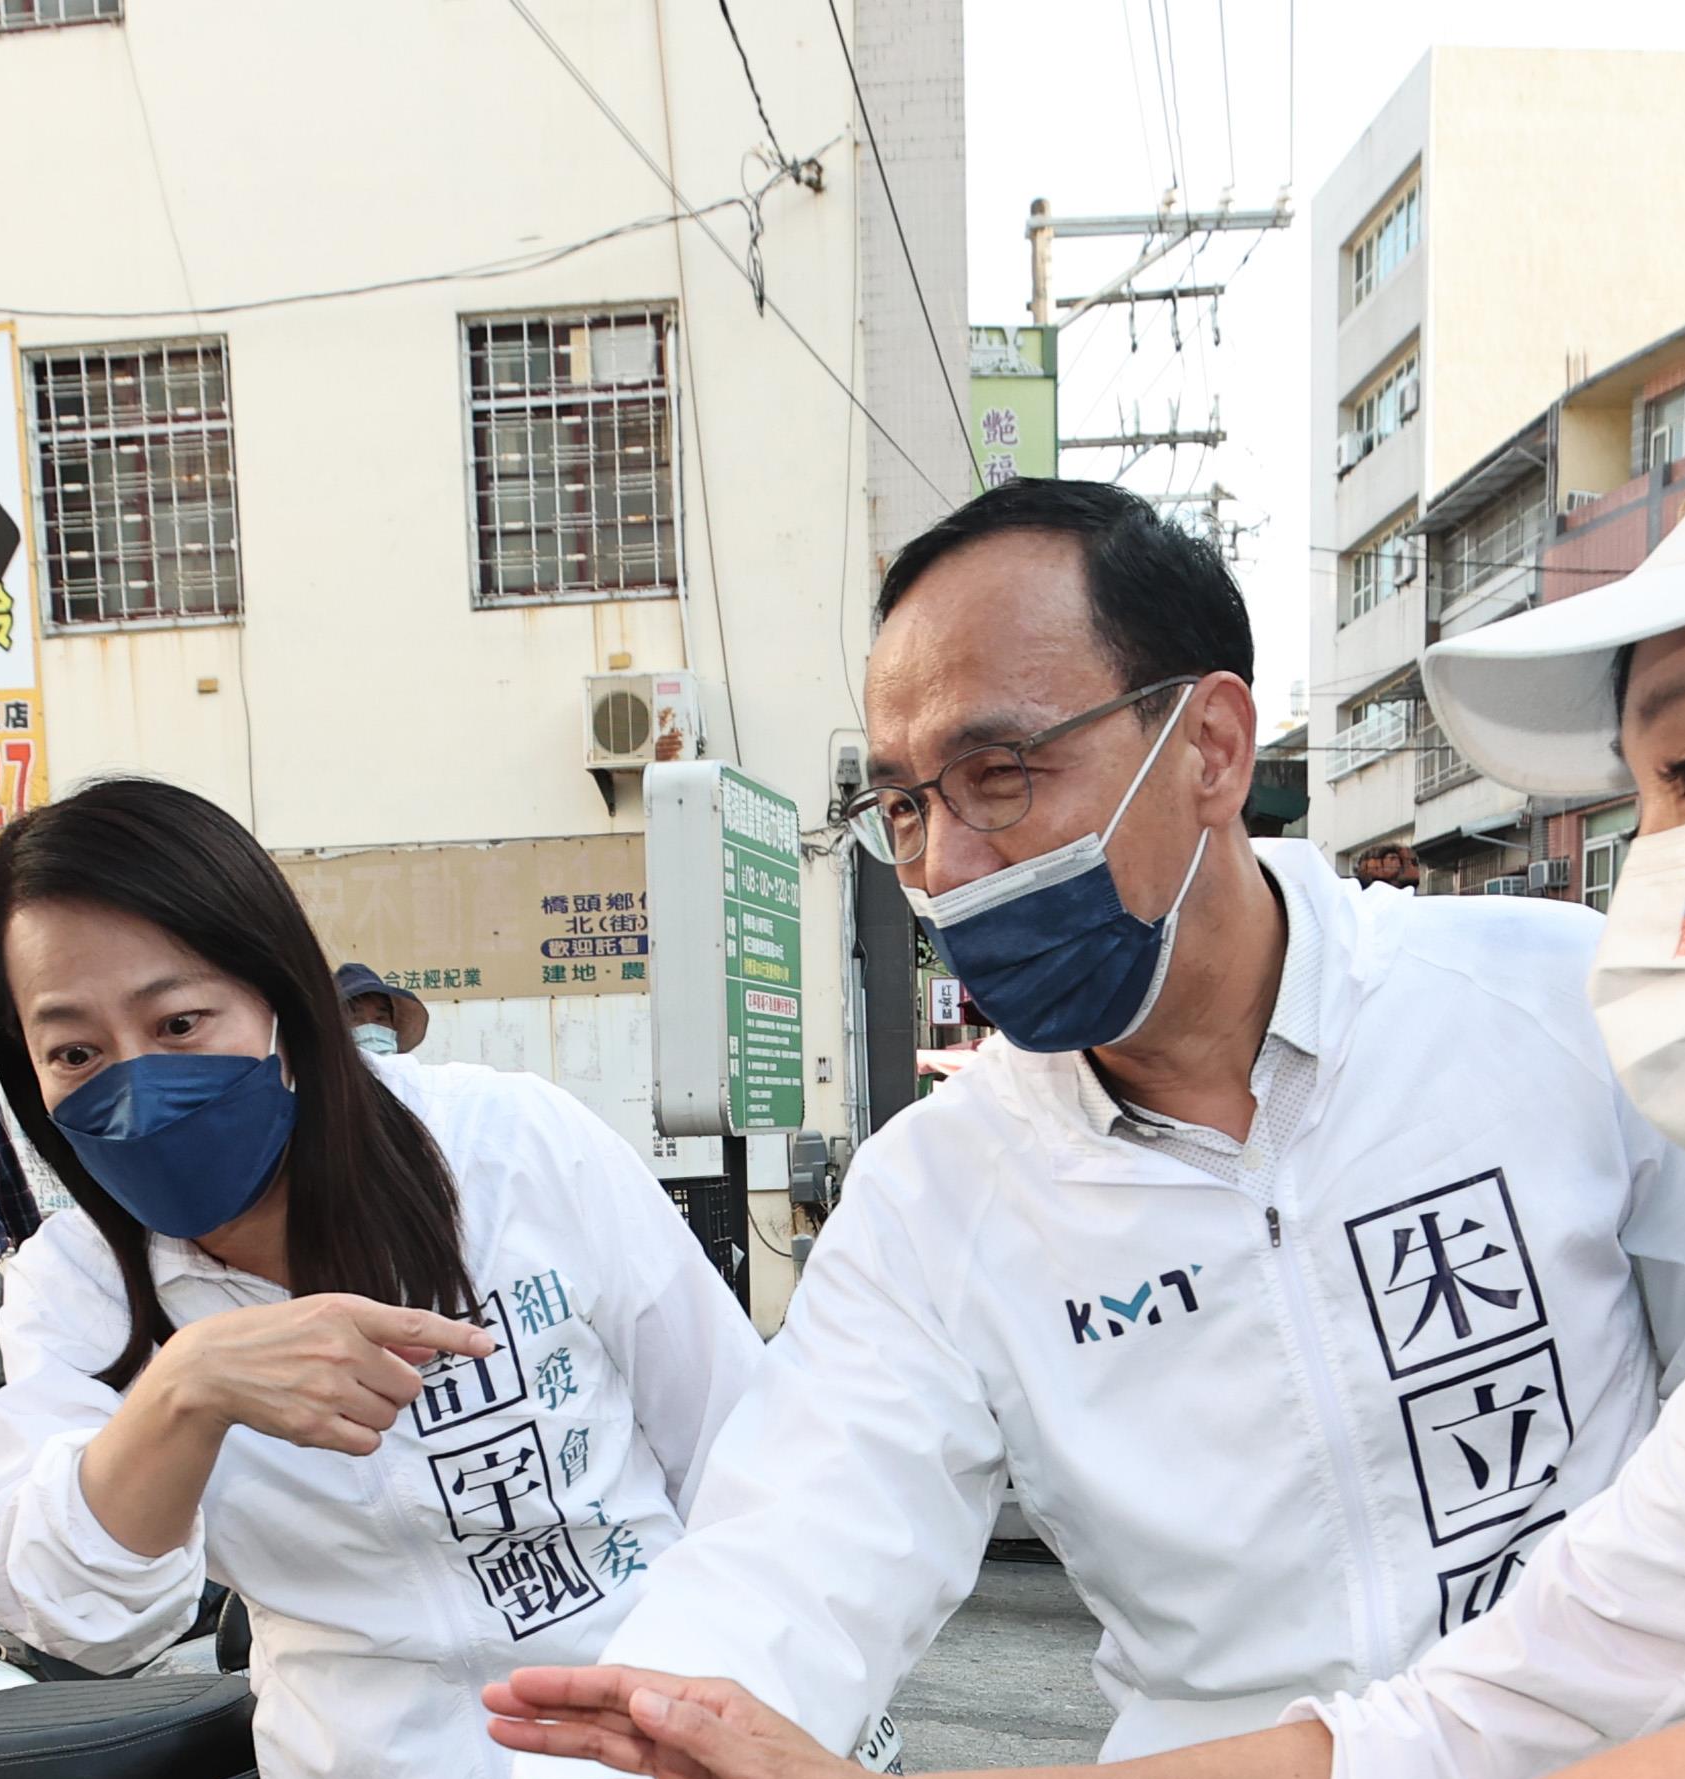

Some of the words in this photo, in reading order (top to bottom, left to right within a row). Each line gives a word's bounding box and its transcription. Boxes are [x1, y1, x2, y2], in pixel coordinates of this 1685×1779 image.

[548, 938, 639, 957] 歡迎託售
[383, 967, 483, 990] 合法經紀業
[1065, 1262, 1204, 1345] KMT
